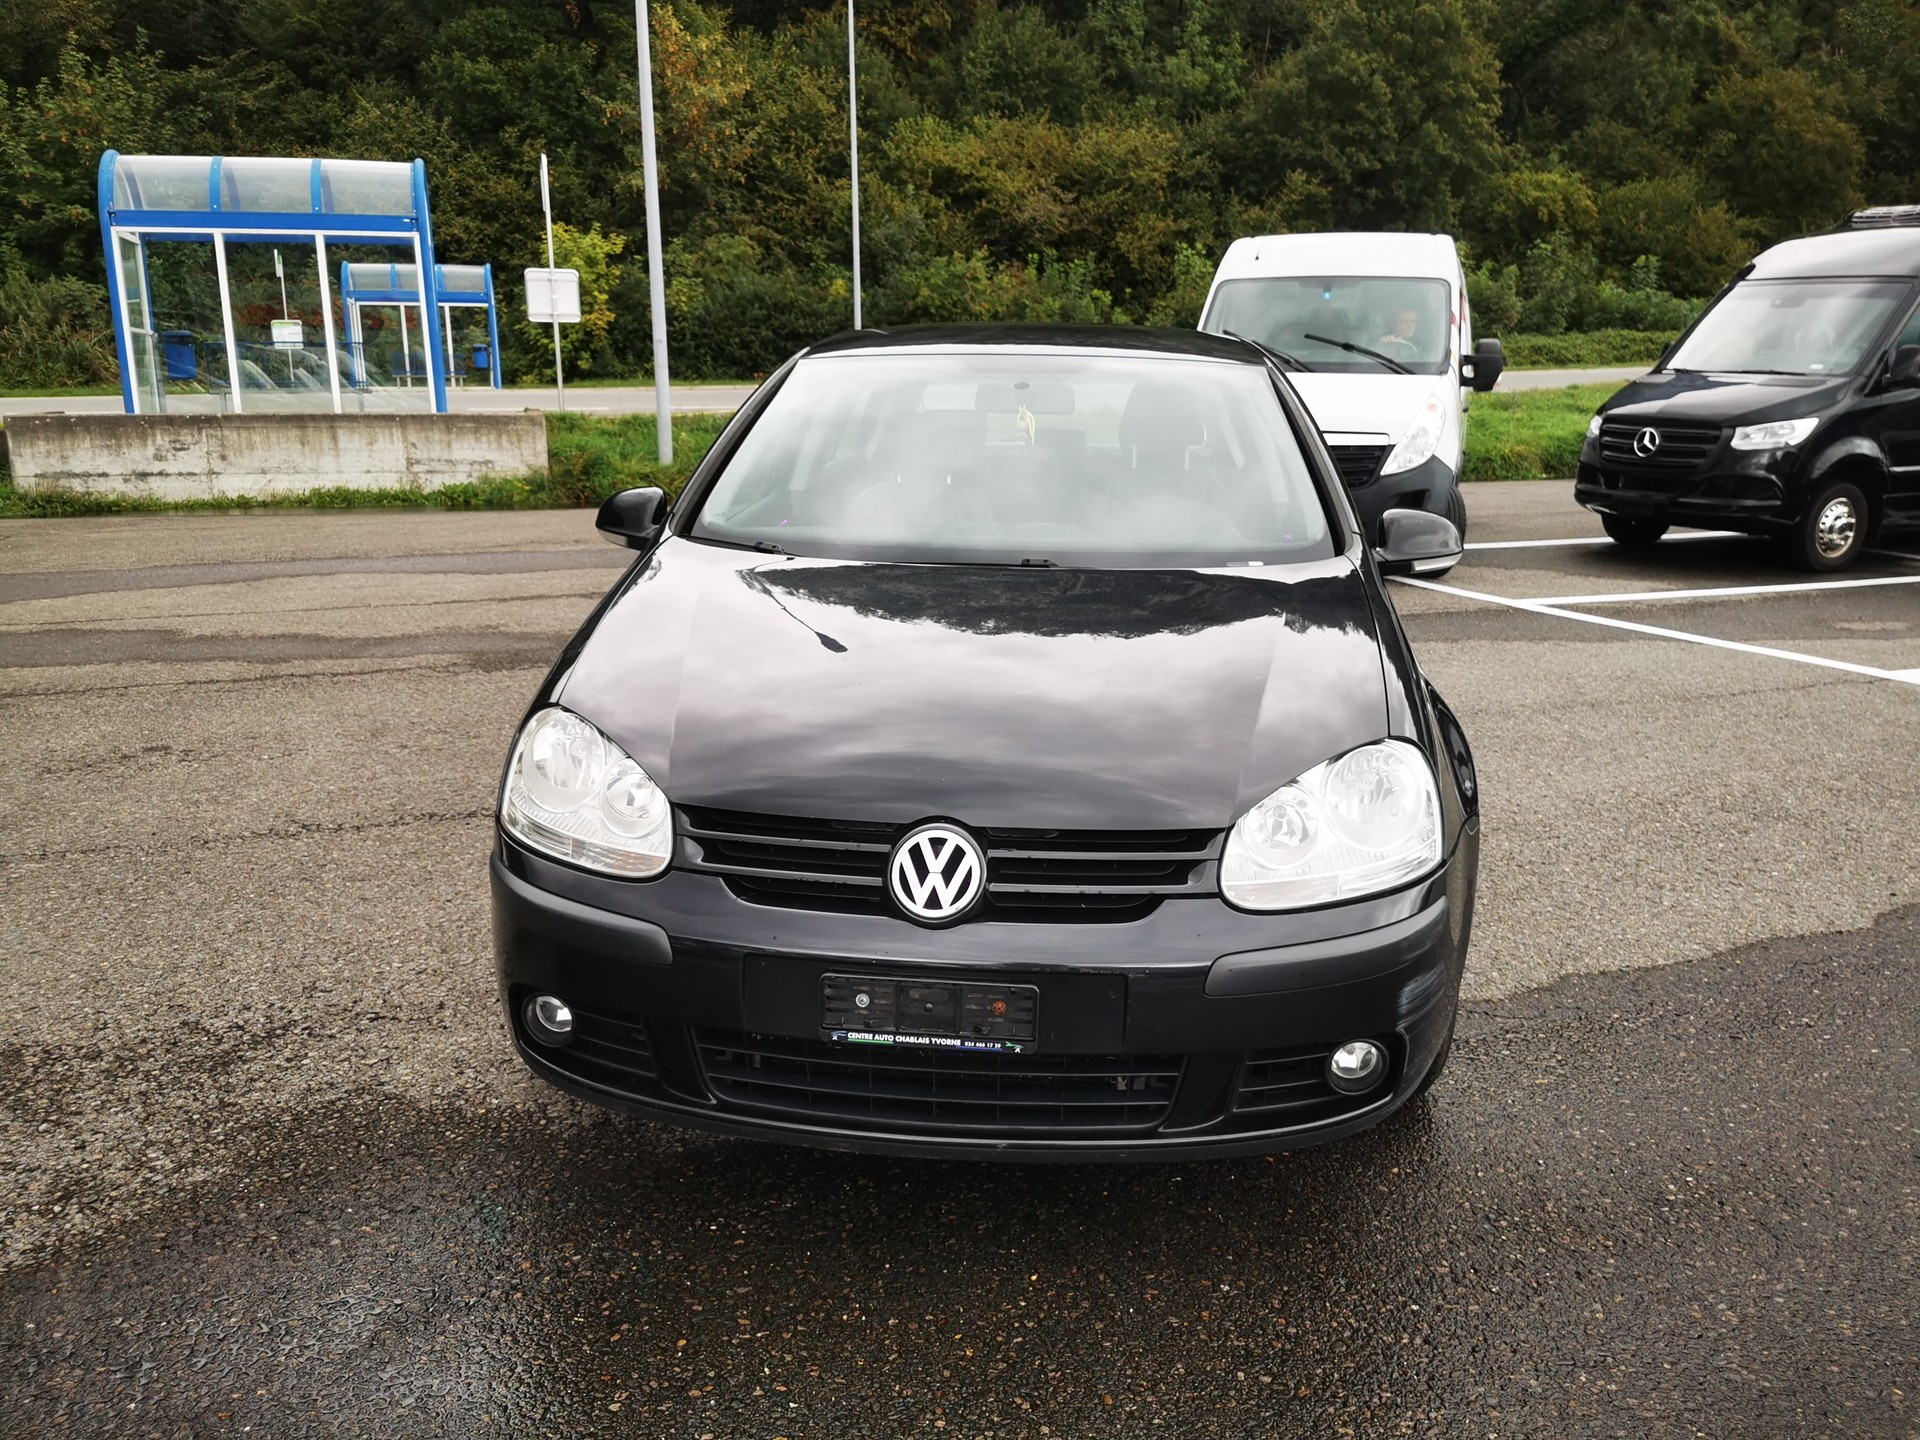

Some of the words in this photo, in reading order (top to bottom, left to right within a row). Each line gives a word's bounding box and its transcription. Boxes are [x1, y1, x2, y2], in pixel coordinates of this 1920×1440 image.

[892, 829, 980, 917] VW
[847, 1032, 873, 1040] CENTRE
[874, 1034, 894, 1042] AUTO
[895, 1035, 930, 1044] CHABLAIS
[931, 1038, 961, 1046] YVORNE
